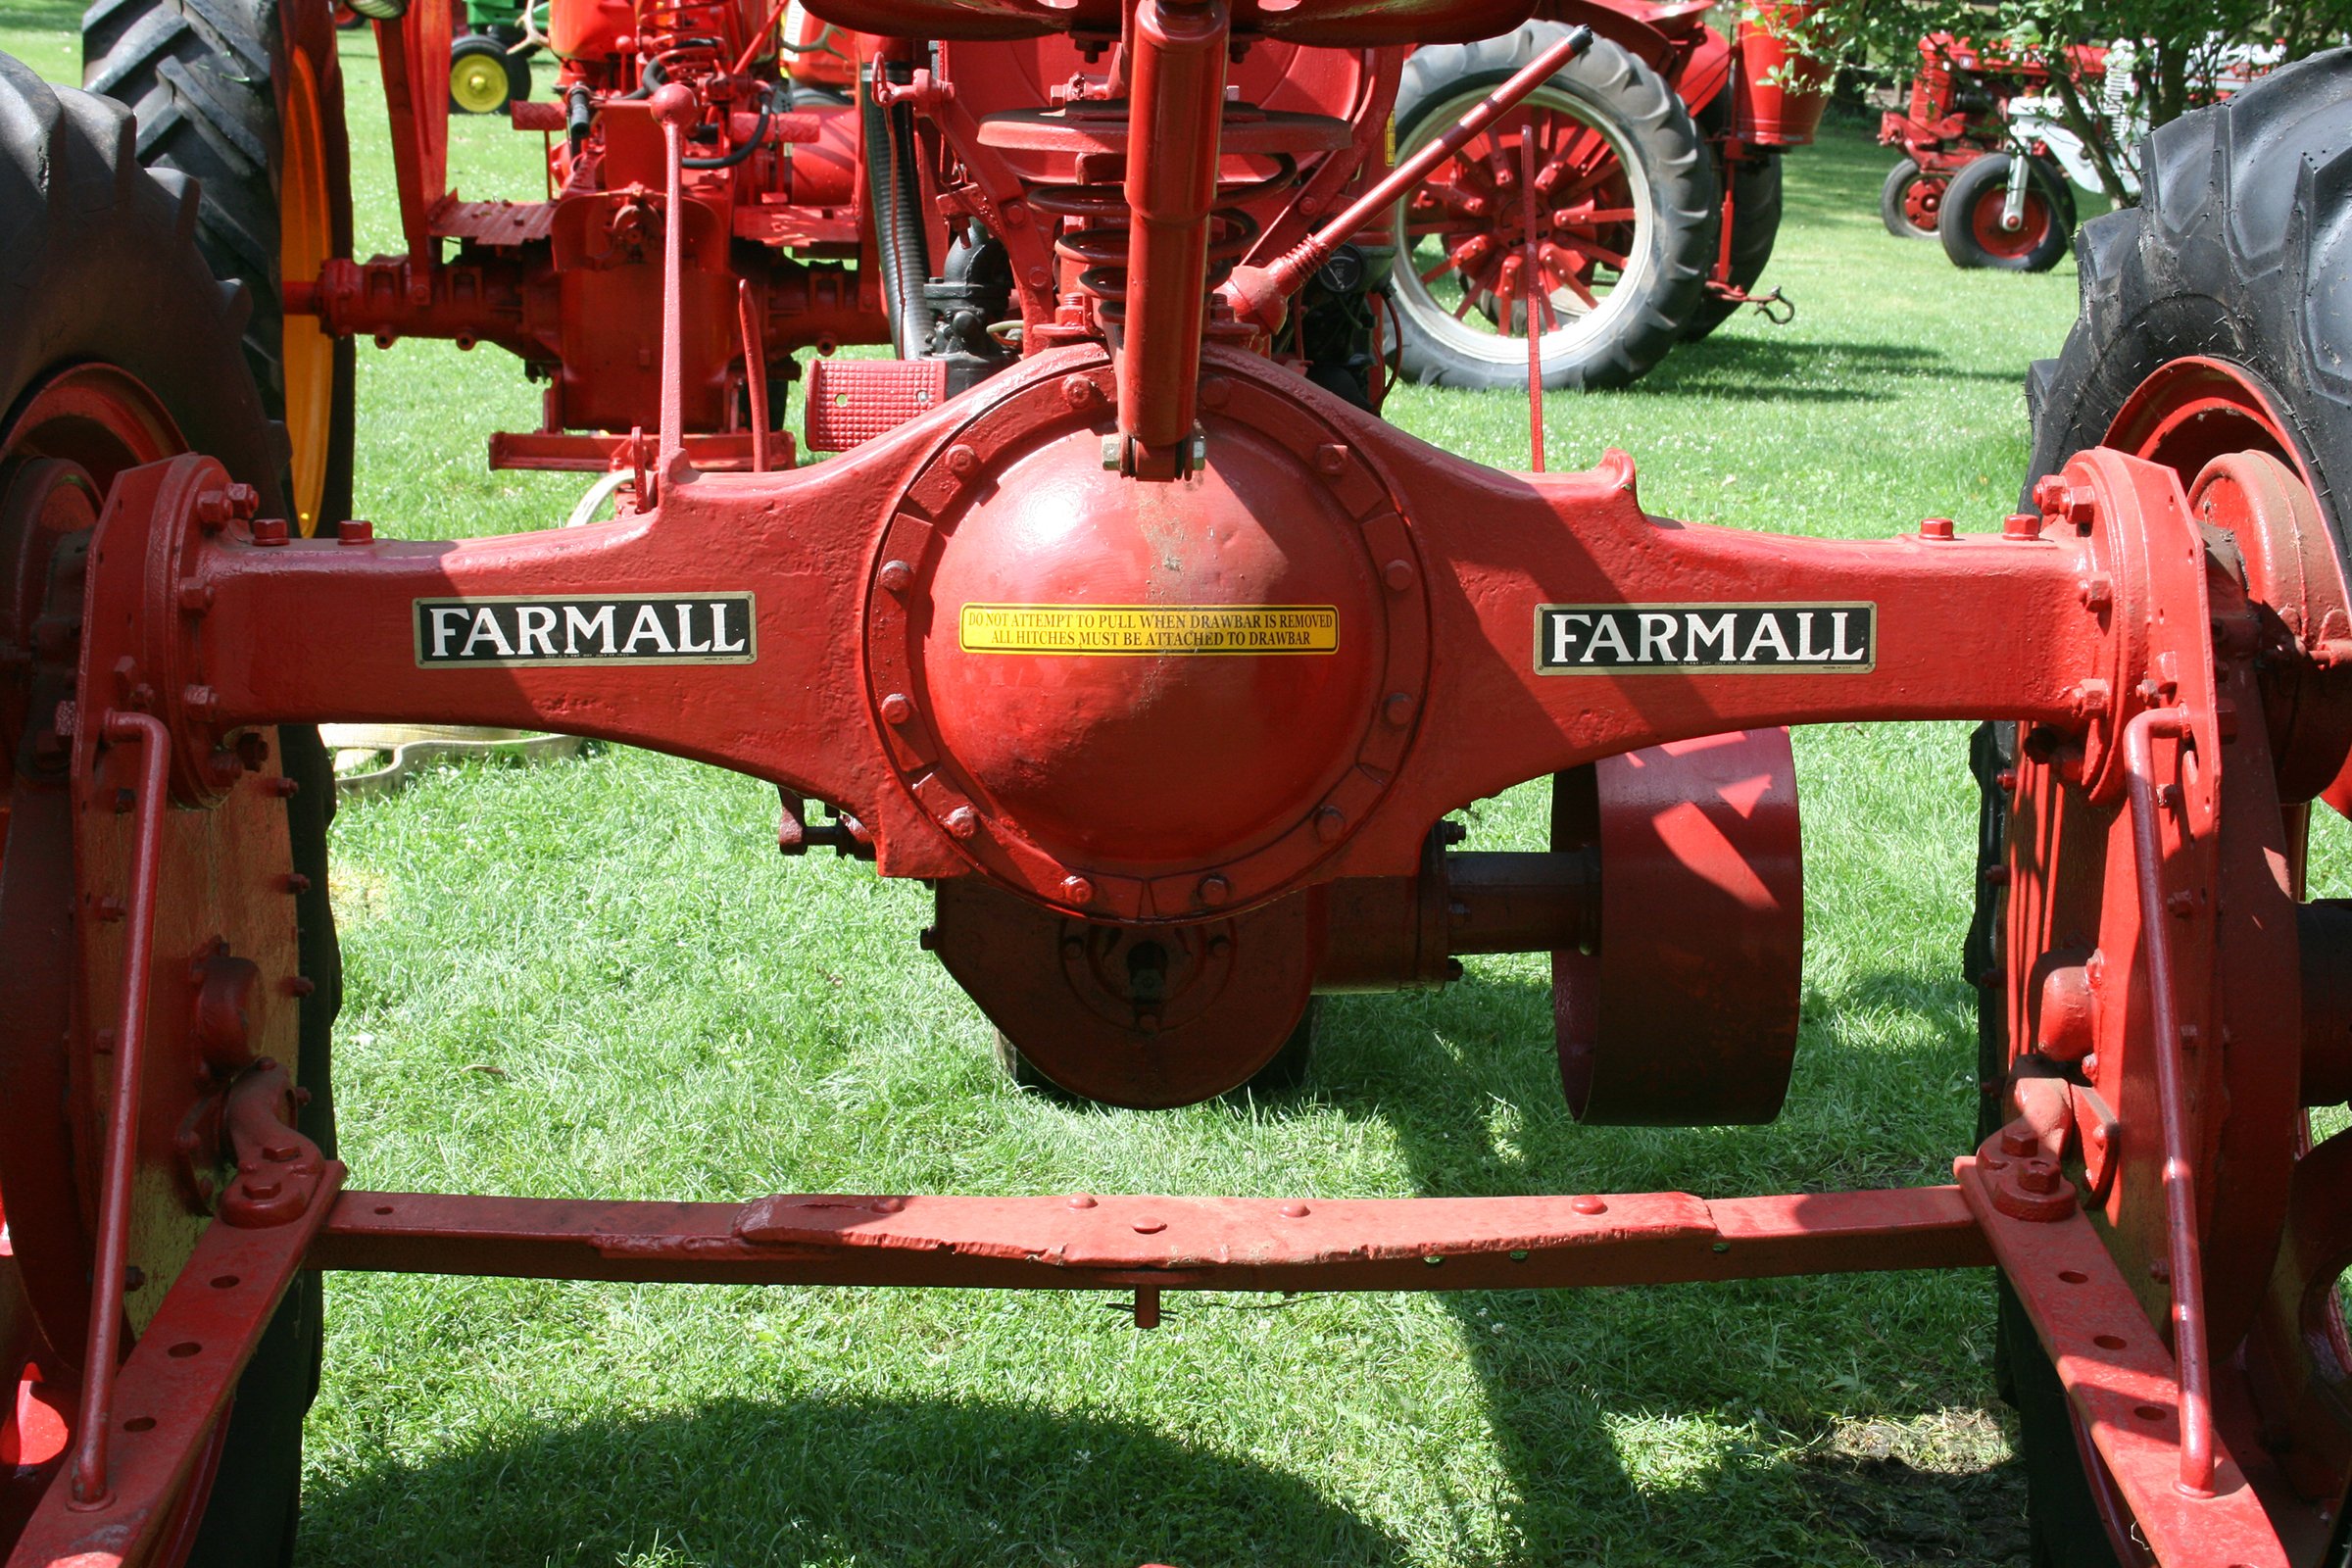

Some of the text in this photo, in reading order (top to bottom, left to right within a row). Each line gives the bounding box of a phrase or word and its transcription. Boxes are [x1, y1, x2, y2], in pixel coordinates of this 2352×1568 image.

[430, 604, 745, 656] FARMALL
[968, 612, 1333, 628] DO NOT ATTEMPT TO PULL WHEN DRAWBAR IS REMOVED
[992, 630, 1310, 646] ALL HITCHES MUST BE ATTACHED TO DRAWBAR
[1551, 612, 1864, 662] FARMALL
